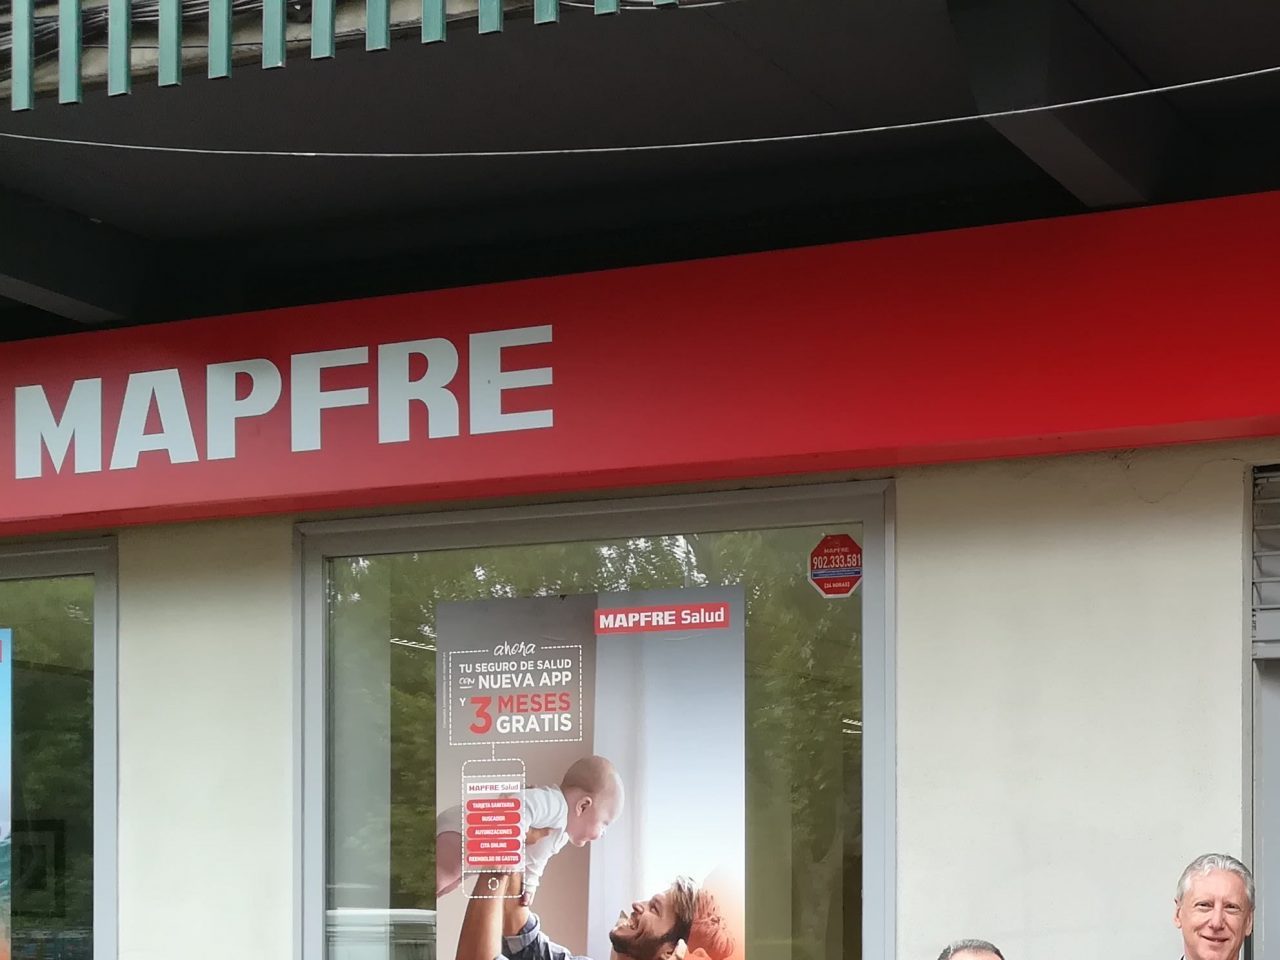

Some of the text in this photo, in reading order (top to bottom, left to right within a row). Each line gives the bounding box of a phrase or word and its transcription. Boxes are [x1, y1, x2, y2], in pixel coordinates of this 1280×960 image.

[14, 324, 554, 480] MAPFRE
[812, 554, 861, 569] 902.333.581
[599, 607, 724, 629] MAPFRE Salud
[494, 641, 536, 656] ahora
[459, 659, 571, 673] TU SEGURO DE SALUD
[478, 674, 534, 689] NUEVA
[539, 671, 572, 687] APP
[459, 693, 571, 735] Y 3 MESES
[496, 714, 572, 734] GRATIS
